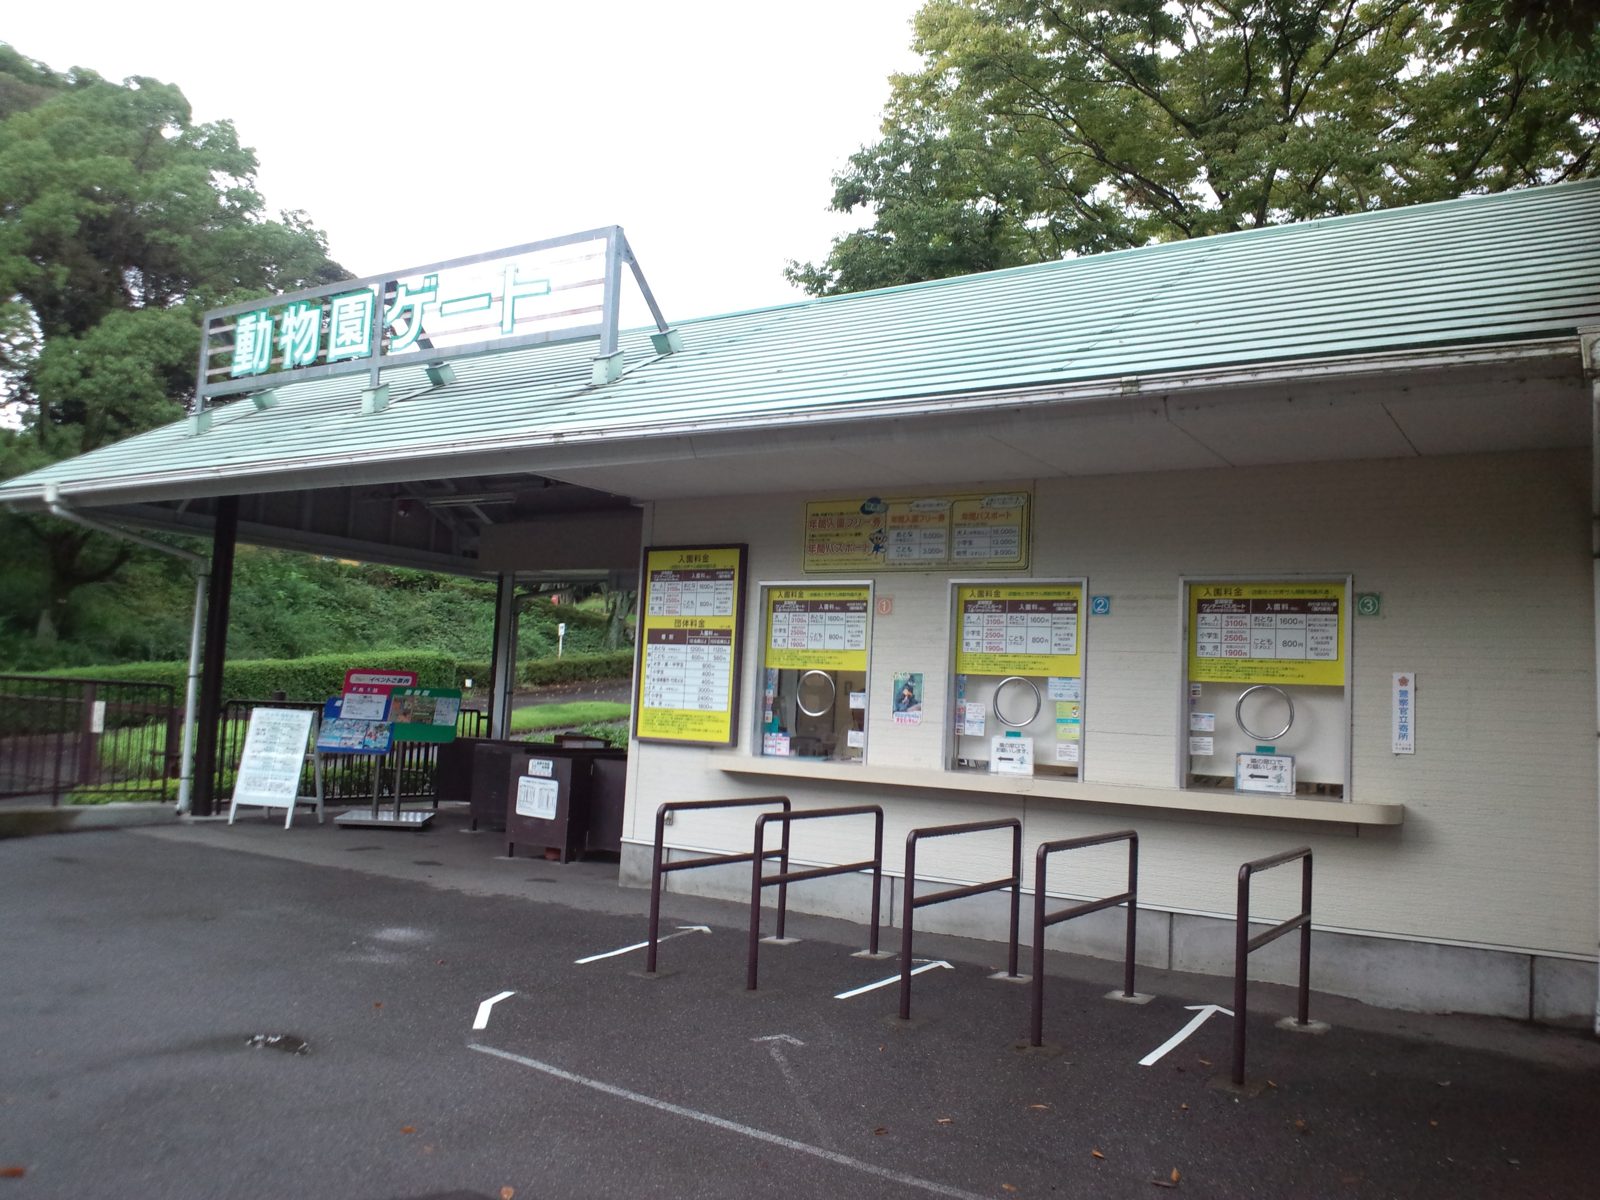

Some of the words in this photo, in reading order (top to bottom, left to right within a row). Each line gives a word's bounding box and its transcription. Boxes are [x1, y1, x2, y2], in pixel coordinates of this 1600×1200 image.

[231, 263, 552, 377] 動物園ゲート
[677, 554, 710, 564] 入園料金
[777, 591, 805, 599] 入園料金
[969, 589, 1002, 599] 入園料金
[1202, 586, 1244, 597] 入園料金
[1018, 603, 1039, 611] 入園料
[1265, 603, 1290, 611] 入園料
[674, 619, 705, 628] 団体料金
[1223, 619, 1248, 627] 3100円
[1253, 615, 1274, 623] おとな
[1279, 617, 1305, 625] 1600円
[1200, 632, 1219, 640] 小学生
[1223, 634, 1248, 643] 2500円
[1281, 640, 1304, 648] 800円
[1224, 649, 1248, 658] 1900円
[1398, 689, 1409, 741] 警察官立寄所
